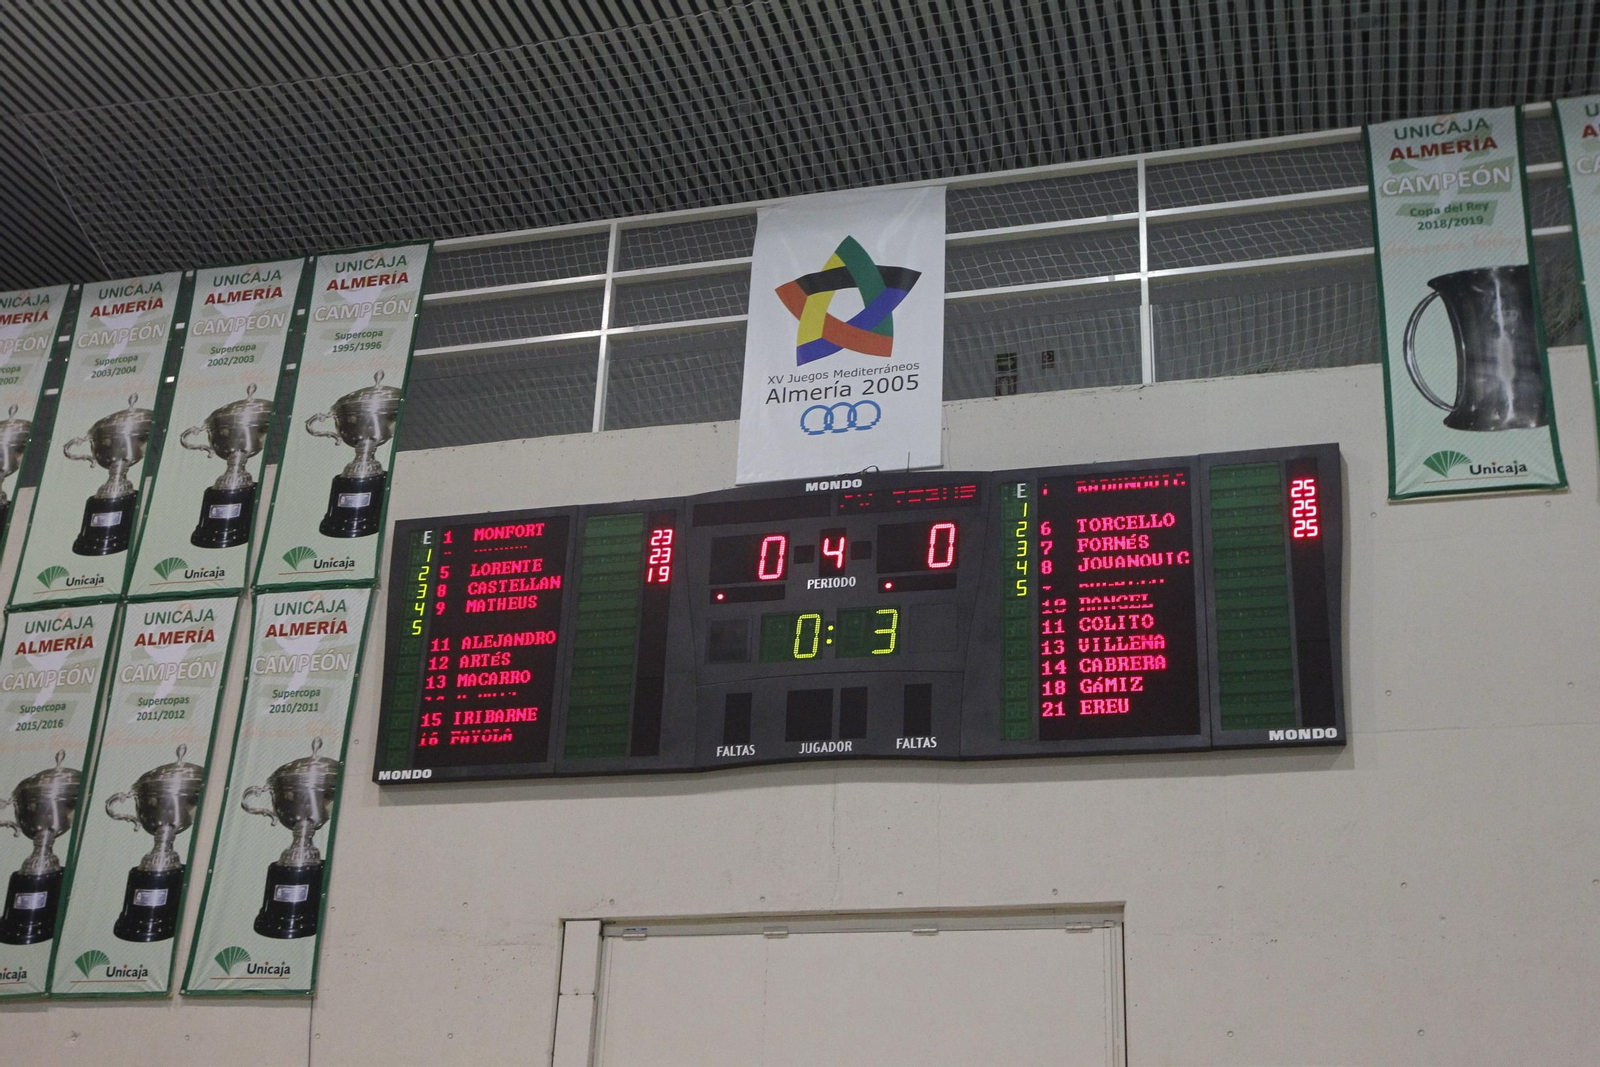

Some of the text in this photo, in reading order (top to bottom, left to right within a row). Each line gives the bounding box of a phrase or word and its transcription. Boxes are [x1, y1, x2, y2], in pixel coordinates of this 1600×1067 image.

[1393, 117, 1490, 140] UNICAJA
[1389, 135, 1498, 161] ALMERÍA
[1381, 164, 1512, 196] CAMPEÓN
[1410, 201, 1490, 219] Copa del Rey
[1417, 214, 1484, 231] 2018/2019
[335, 254, 407, 274] UNICAJA
[213, 269, 282, 287] UNICAJA
[326, 270, 409, 291] ALMERÍA
[99, 281, 163, 300] UNICAJA
[204, 286, 283, 305] ALMERÍA
[90, 297, 164, 318] ALMERÍA
[314, 298, 412, 323] CAMPEÓN
[192, 311, 286, 336] CAMPEÓN
[77, 323, 166, 349] CAMPEÓN
[334, 329, 384, 342] Supercopa
[210, 343, 257, 356] Supercopa
[331, 340, 382, 353] 1995/1996
[94, 354, 139, 368] Supercopa
[207, 354, 255, 367] 2002/2003
[91, 365, 137, 379] 2003/2004
[767, 362, 920, 386] XV Juegos Mediterráneos
[765, 374, 919, 405] Almería 2005
[1469, 460, 1528, 476] Unicaja
[805, 478, 863, 492] MONDO
[1016, 483, 1027, 498] E
[1291, 479, 1316, 498] 25
[1022, 502, 1028, 517] 1
[1292, 499, 1317, 518] 25
[1016, 521, 1028, 538] 2
[1040, 512, 1176, 536] 6 TORCELLO
[1293, 519, 1319, 538] 25
[422, 530, 432, 545] E
[443, 523, 545, 544] 1 MONFORT
[650, 529, 673, 546] 23
[823, 536, 845, 569] 4
[927, 523, 955, 568] 0
[1016, 540, 1028, 557] 3
[1040, 540, 1053, 555] 7
[313, 555, 355, 572] Unicaja
[426, 549, 432, 562] 1
[649, 547, 671, 564] 23
[758, 535, 786, 580] 0
[184, 566, 225, 581] Unicaja
[418, 566, 430, 581] 2
[439, 558, 543, 579] 5 LORENTE
[647, 566, 670, 583] 19
[1016, 560, 1028, 576] 4
[1041, 560, 1053, 575] 8
[65, 573, 104, 588] Unicaja
[436, 575, 562, 598] 8 CASTELLAN
[807, 576, 857, 590] PERIODO
[1016, 579, 1028, 597] 5
[417, 584, 428, 599] 3
[273, 600, 347, 617] UNICAJA
[414, 602, 425, 616] 4
[435, 595, 538, 616] 9 MATHEUS
[25, 616, 93, 634] UNICAJA
[143, 609, 215, 626] UNICAJA
[1041, 613, 1155, 635] 11 COLITO
[265, 619, 349, 638] ALMERÍA
[411, 619, 422, 635] 5
[15, 634, 94, 655] ALMERÍA
[134, 629, 216, 647] ALMERÍA
[431, 630, 557, 652] 11 ALEJANDRO
[1041, 633, 1166, 656] 13 VILLENA
[251, 649, 350, 676] CAMPEÓN
[428, 656, 449, 671] 12
[1041, 654, 1167, 676] 14 CABRERA
[2, 664, 95, 691] CAMPEÓN
[120, 659, 218, 684] CAMPEÓN
[425, 670, 531, 689] 13 MACARRO
[272, 688, 321, 700] Supercopa
[1042, 680, 1067, 697] 18
[20, 703, 66, 715] Supercopa
[138, 696, 190, 708] Supercopas
[269, 701, 319, 714] 2010/2011
[1042, 698, 1130, 717] 21 EREU
[136, 709, 185, 722] 2011/2012
[420, 707, 538, 728] 15 IRIBARNE
[16, 719, 63, 732] 2015/2016
[896, 736, 937, 750] FALTAS
[1269, 727, 1338, 742] MONDO
[716, 744, 756, 757] FALTAS
[799, 740, 853, 754] JUGADOR
[378, 769, 432, 782] MONDO
[105, 962, 149, 980] Unicaja
[247, 961, 291, 978] Unicaja
